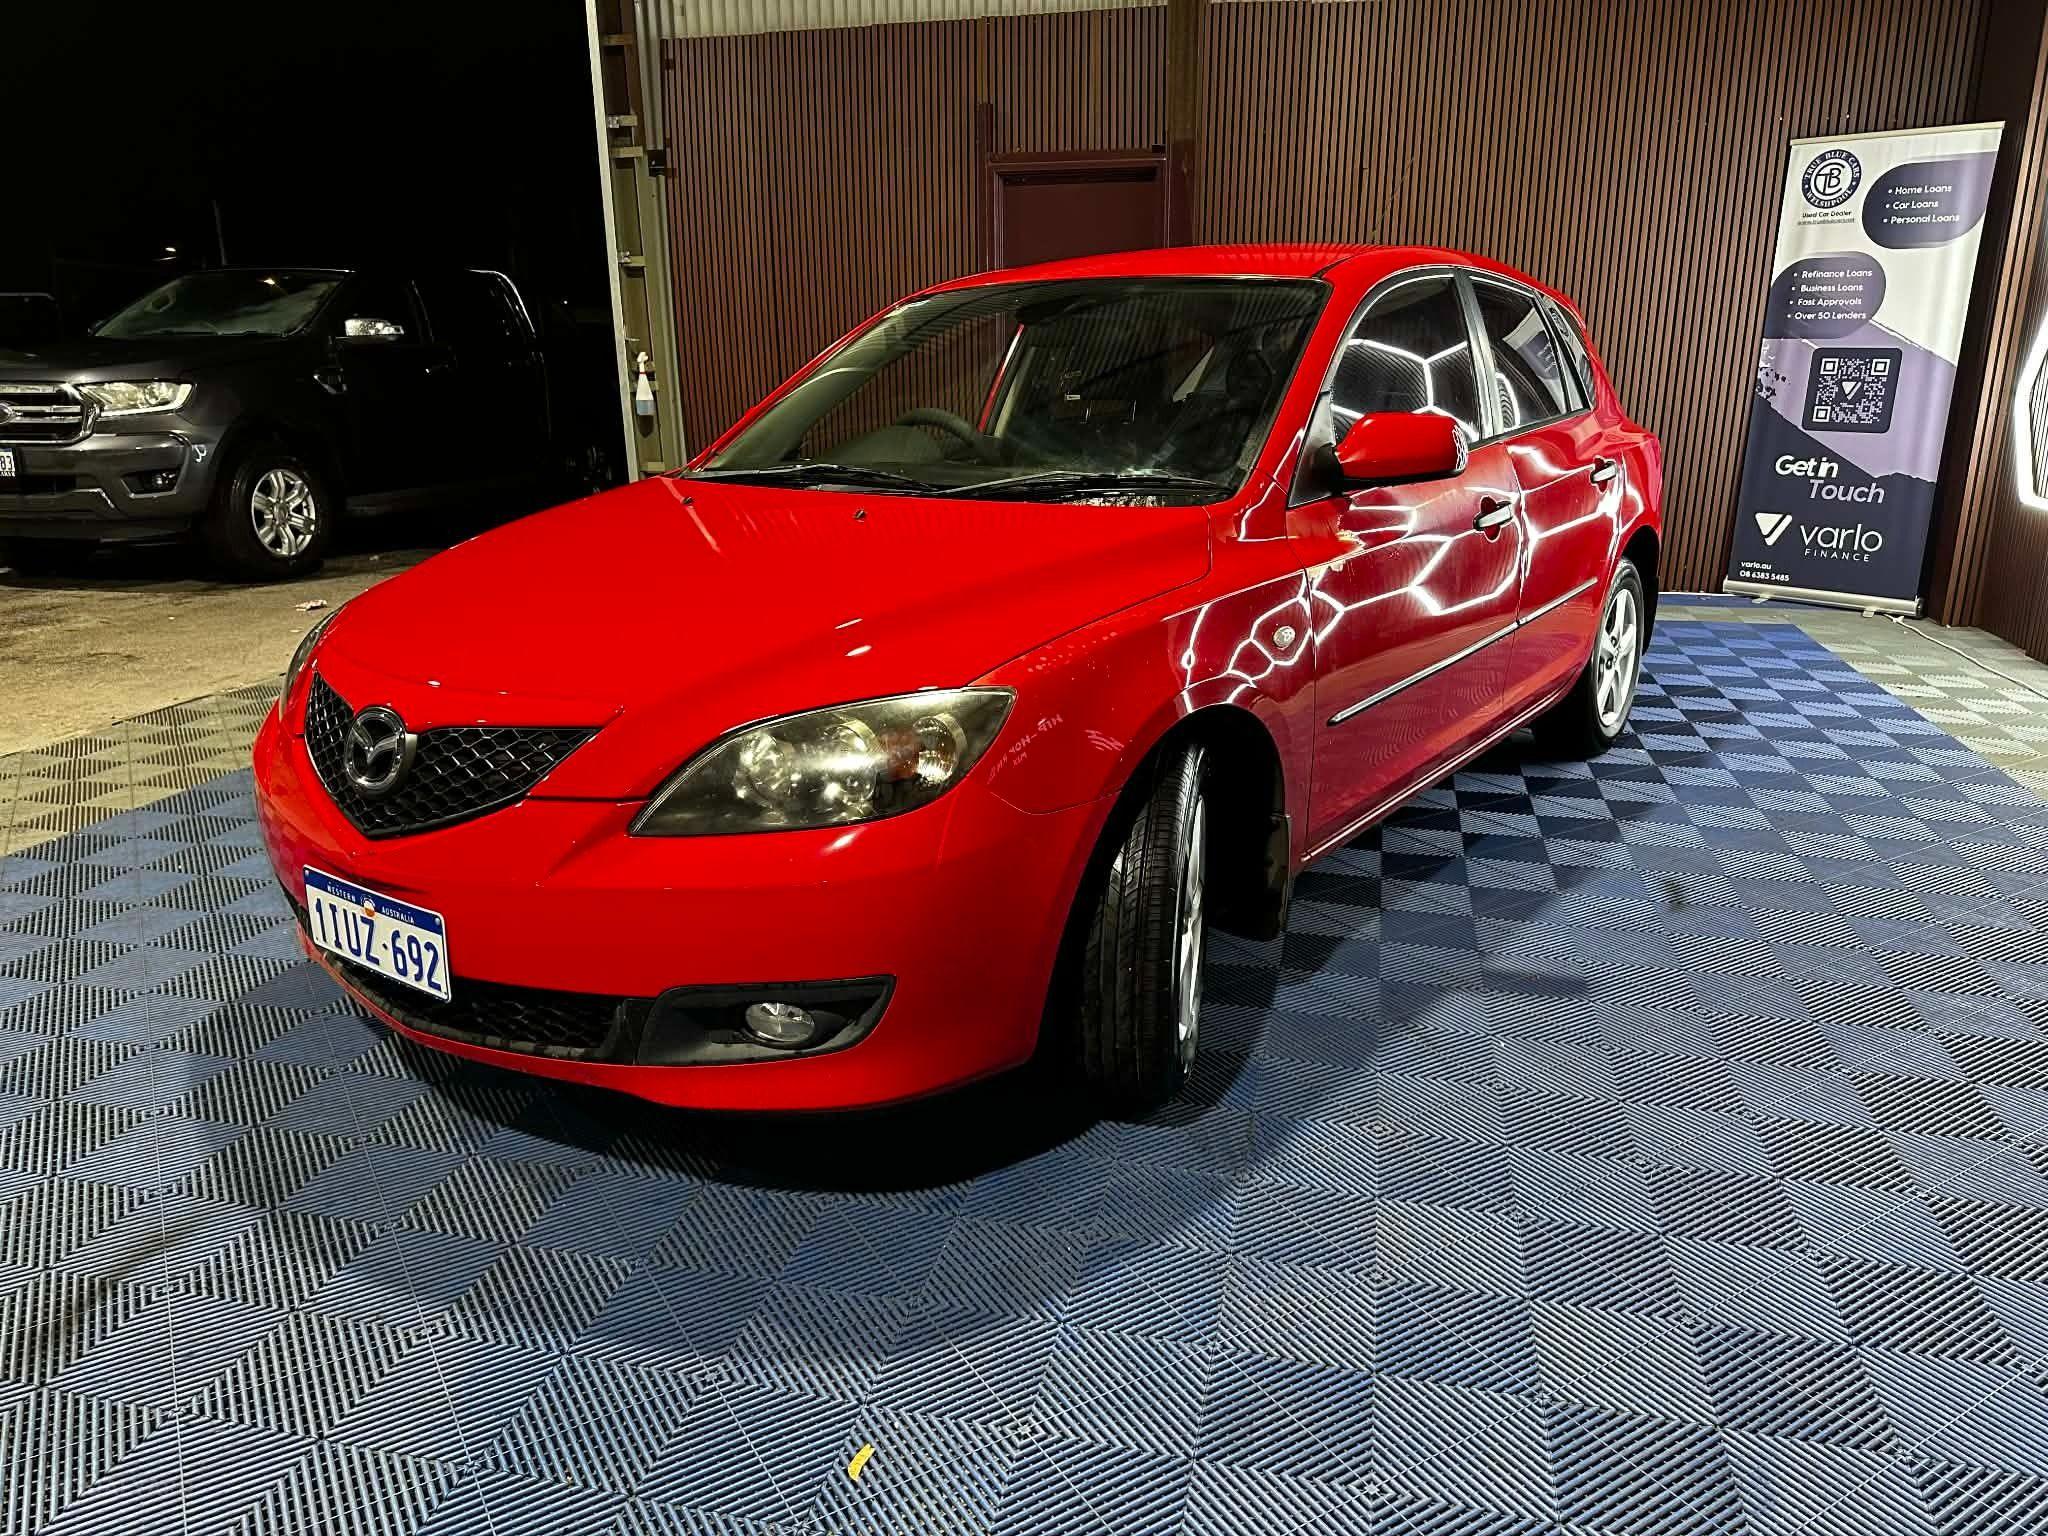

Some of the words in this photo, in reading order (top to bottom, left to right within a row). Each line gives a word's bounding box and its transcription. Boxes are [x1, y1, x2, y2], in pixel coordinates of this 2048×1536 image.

[1825, 151, 1848, 160] BLUE
[1848, 156, 1860, 178] CARS
[1895, 186, 1922, 195] Home
[1924, 185, 1952, 193] Loans
[1892, 202, 1909, 210] Car
[1911, 200, 1938, 209] Loans
[1890, 215, 1931, 224] Personal
[1932, 214, 1960, 222] Loans
[1801, 271, 1845, 279] Refinance
[1846, 269, 1873, 277] Loans
[1800, 284, 1836, 292] Business
[1837, 283, 1863, 292] Loans
[1797, 298, 1815, 306] Fast
[1816, 297, 1862, 307] Approvals
[1794, 311, 1816, 320] Over
[1818, 311, 1831, 319] 50
[1832, 311, 1867, 320] Lenders
[1775, 455, 1816, 477] Get
[1817, 457, 1839, 478] in
[1809, 479, 1885, 504] Touch
[1800, 523, 1883, 552] varlo
[1804, 549, 1871, 562] FINANCE
[1741, 561, 1772, 570] varlo.au
[1739, 570, 1751, 578] 08
[1770, 573, 1790, 581] 5485
[327, 885, 356, 902] WESTERN
[381, 905, 415, 925] AUSTRALIA
